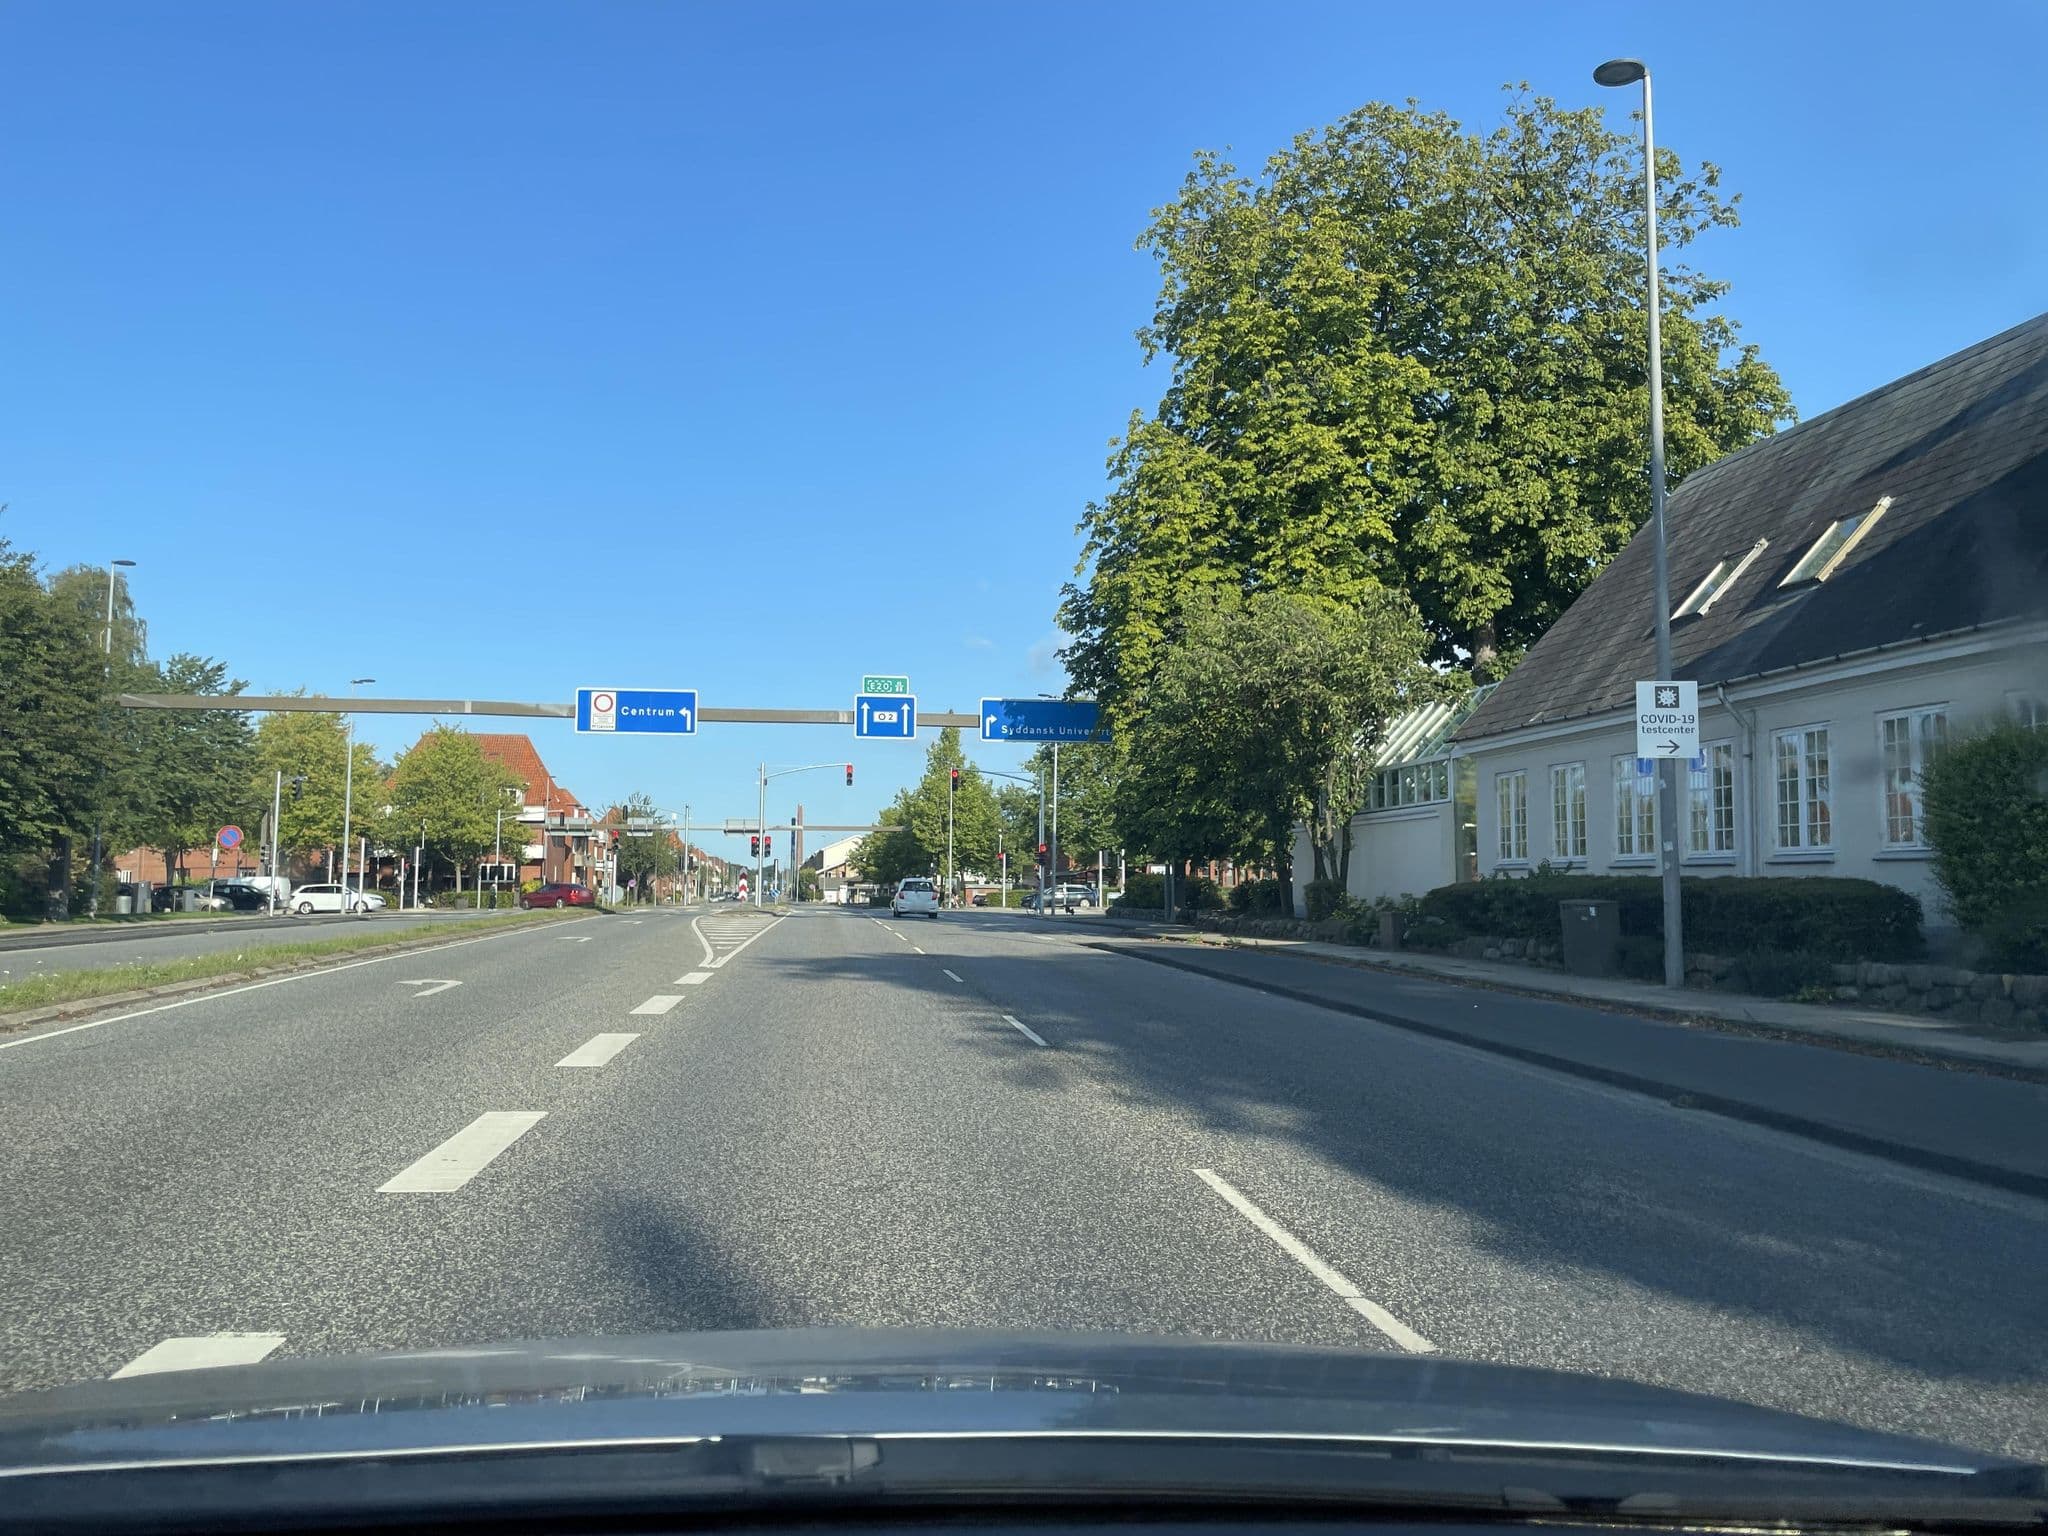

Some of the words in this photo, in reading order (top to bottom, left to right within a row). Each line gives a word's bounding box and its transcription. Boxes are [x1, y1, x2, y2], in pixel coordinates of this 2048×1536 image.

[870, 682, 890, 691] E20
[621, 706, 675, 717] Centrum
[1641, 714, 1695, 724] COVID-19
[1001, 725, 1055, 736] Syddansk
[1642, 726, 1695, 734] testcenter
